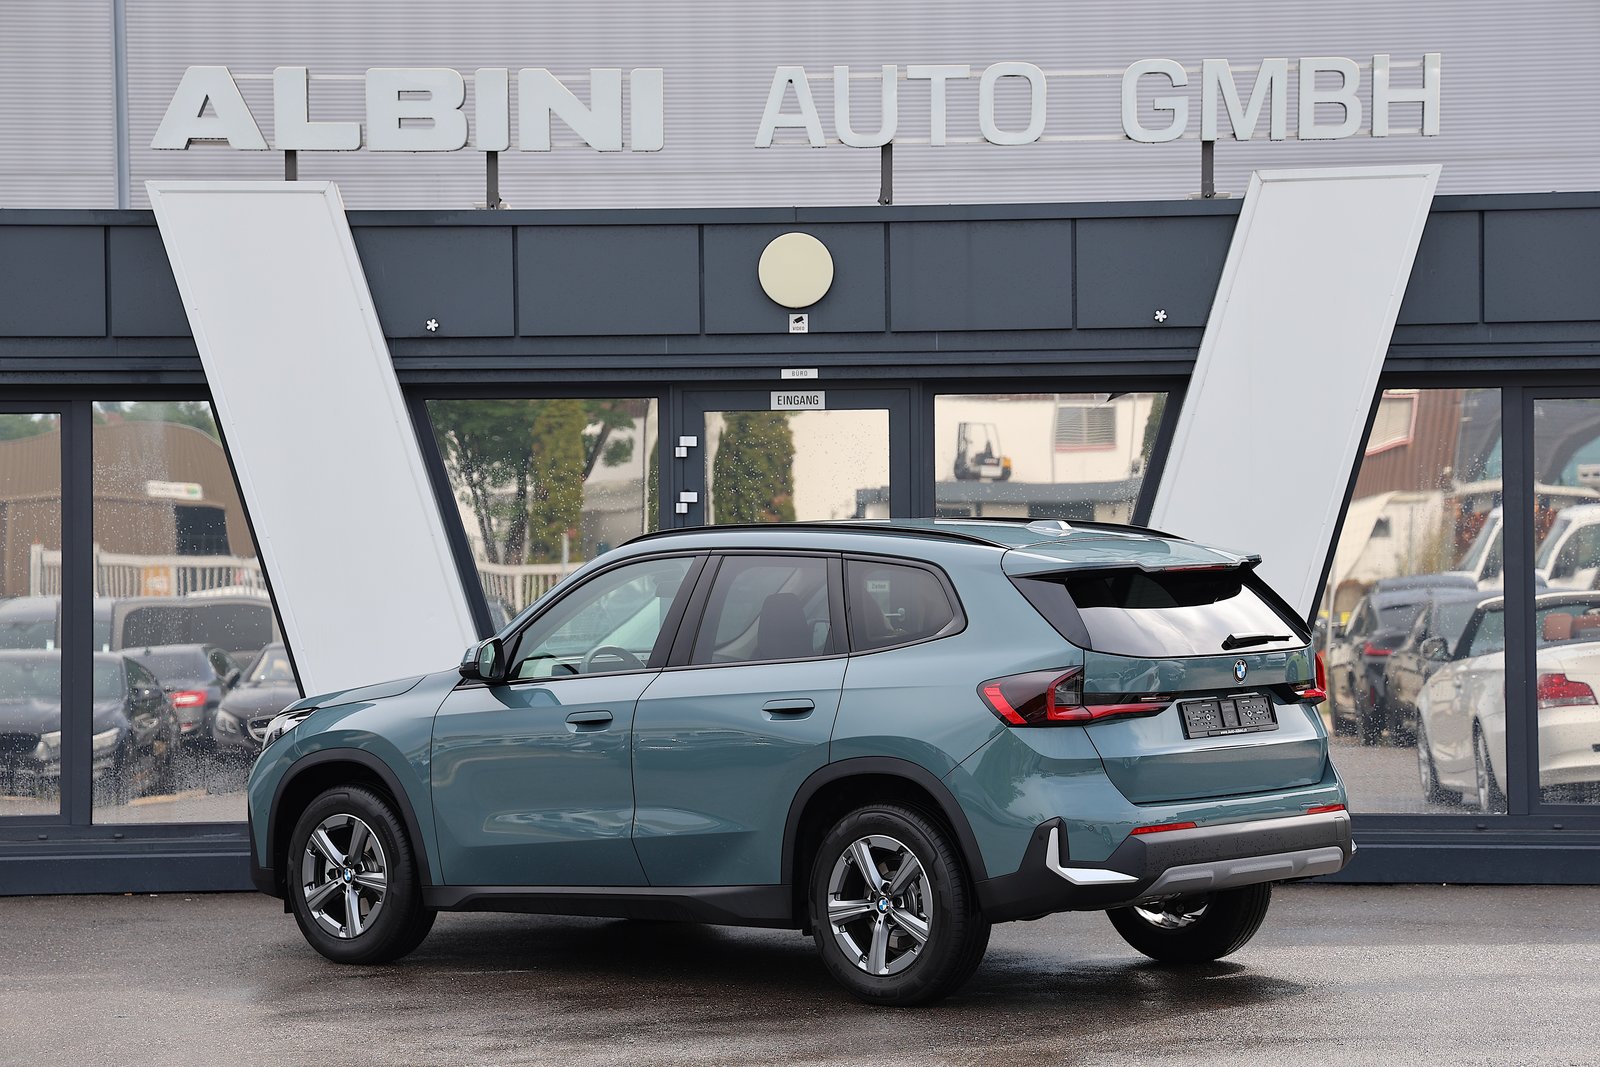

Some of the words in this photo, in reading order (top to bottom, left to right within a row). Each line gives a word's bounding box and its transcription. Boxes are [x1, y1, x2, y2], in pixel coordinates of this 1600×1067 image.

[150, 66, 664, 152] ALBINI
[754, 61, 1047, 149] AUTO
[1121, 52, 1442, 144] GMBH
[777, 395, 819, 406] EINGANG
